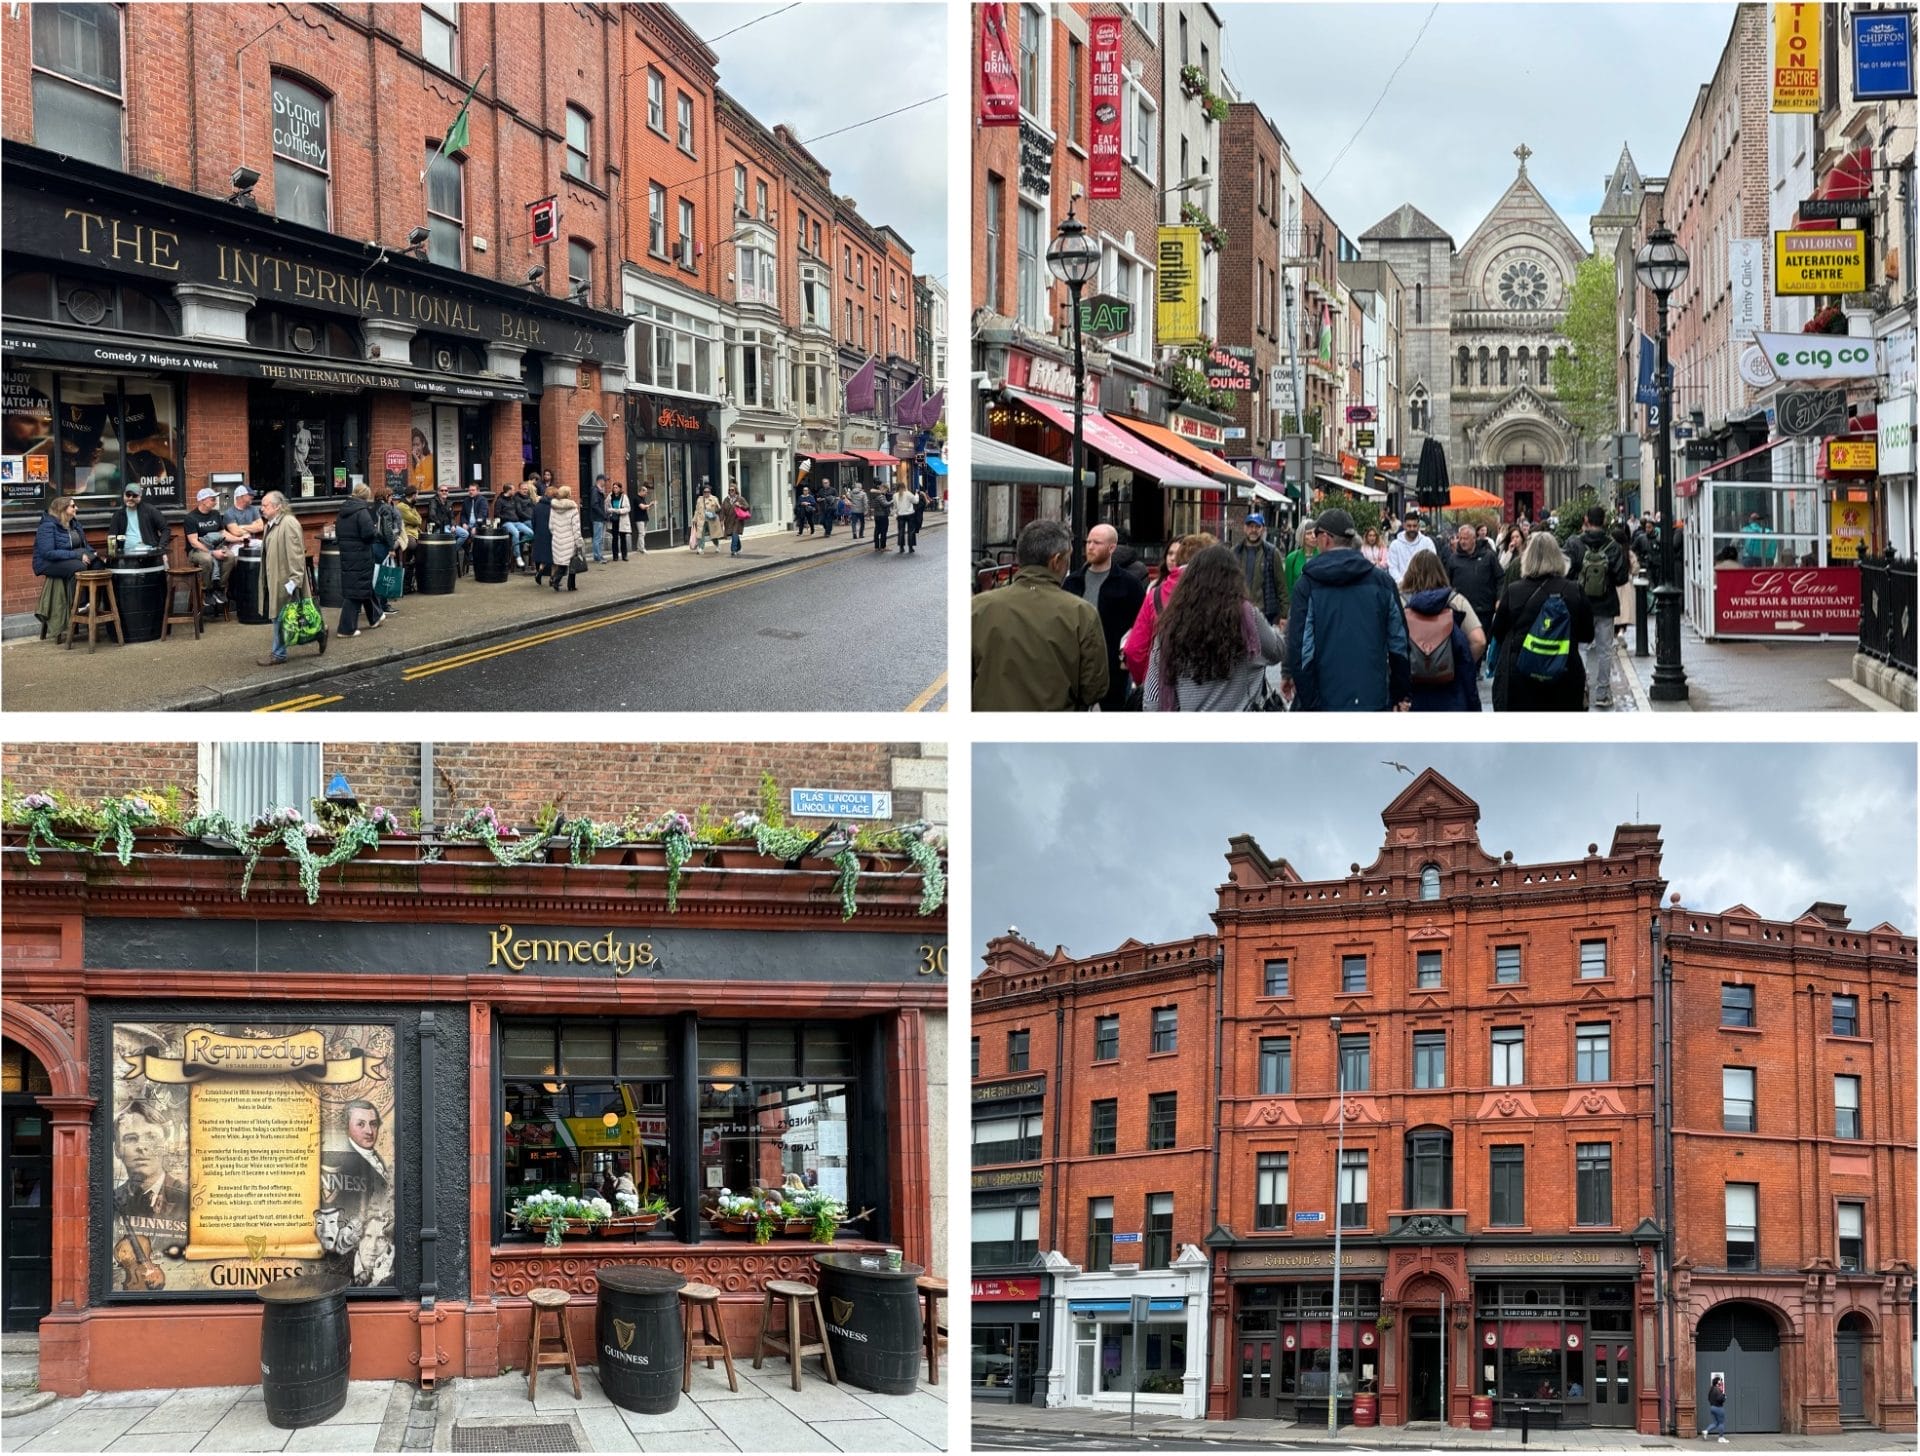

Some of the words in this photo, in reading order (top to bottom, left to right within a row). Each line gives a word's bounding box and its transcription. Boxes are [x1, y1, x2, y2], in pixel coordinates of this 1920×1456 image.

[1859, 32, 1904, 43] CHIFFON
[1095, 51, 1117, 62] AIN'T
[1101, 62, 1112, 73] NO
[1094, 74, 1118, 85] FINER
[1779, 70, 1816, 86] CENTRE
[1093, 85, 1118, 96] DINER
[273, 91, 321, 128] Stand
[1098, 134, 1113, 144] EAT
[1093, 144, 1118, 155] DRINK
[1802, 202, 1870, 216] RESTAURANT
[1790, 237, 1852, 249] TAILORING
[1785, 254, 1860, 267] ALTERATIONS
[65, 207, 180, 271] THE
[216, 243, 481, 333] INTERNATIONAL
[1160, 241, 1191, 303] GOTHAM
[1742, 257, 1753, 288] Clinic
[1801, 268, 1844, 280] CENTRE
[1829, 280, 1860, 289] GENTS
[1742, 289, 1755, 325] Trinity
[1080, 303, 1129, 332] EAT
[22, 341, 37, 349] BAR
[94, 349, 138, 364] Comedy
[140, 354, 147, 362] 7
[149, 354, 181, 367] Nights
[183, 359, 191, 367] A
[192, 359, 219, 370] Week
[1775, 352, 1790, 366] e
[1795, 349, 1833, 369] cig
[1838, 347, 1870, 363] co
[260, 364, 287, 378] THE
[289, 367, 378, 386] INTERNATIONAL
[380, 376, 400, 388] BAR
[1273, 369, 1302, 380] COSMC
[414, 381, 428, 390] Live
[428, 383, 447, 393] Music
[1208, 377, 1251, 390] OUNGE
[1275, 382, 1294, 393] DOCTO
[1649, 406, 1659, 425] 2
[61, 419, 92, 433] UINNESS
[140, 476, 157, 485] ONE
[153, 487, 175, 496] TIME
[1746, 571, 1783, 594] La
[1788, 571, 1839, 594] Cave
[1730, 597, 1758, 606] WINE
[1759, 597, 1779, 606] BAR
[1781, 597, 1789, 606] &
[1790, 596, 1855, 606] RESTAURANT
[1722, 610, 1759, 620] OLDEST
[1761, 610, 1788, 619] WINE
[1790, 610, 1810, 619] BAR
[1812, 609, 1824, 619] IN
[1826, 609, 1862, 619] DUBLIN
[829, 794, 867, 804] LINCOLN
[796, 803, 835, 813] LINCOLN
[840, 804, 870, 814] PLACE
[489, 924, 654, 975] Kennedys
[190, 1035, 320, 1067] Kennedys
[1264, 1251, 1321, 1267] Lincoln's
[1503, 1250, 1564, 1264] Lincoln's
[1572, 1250, 1600, 1264] Inn
[603, 1343, 649, 1366] GUINNESS
